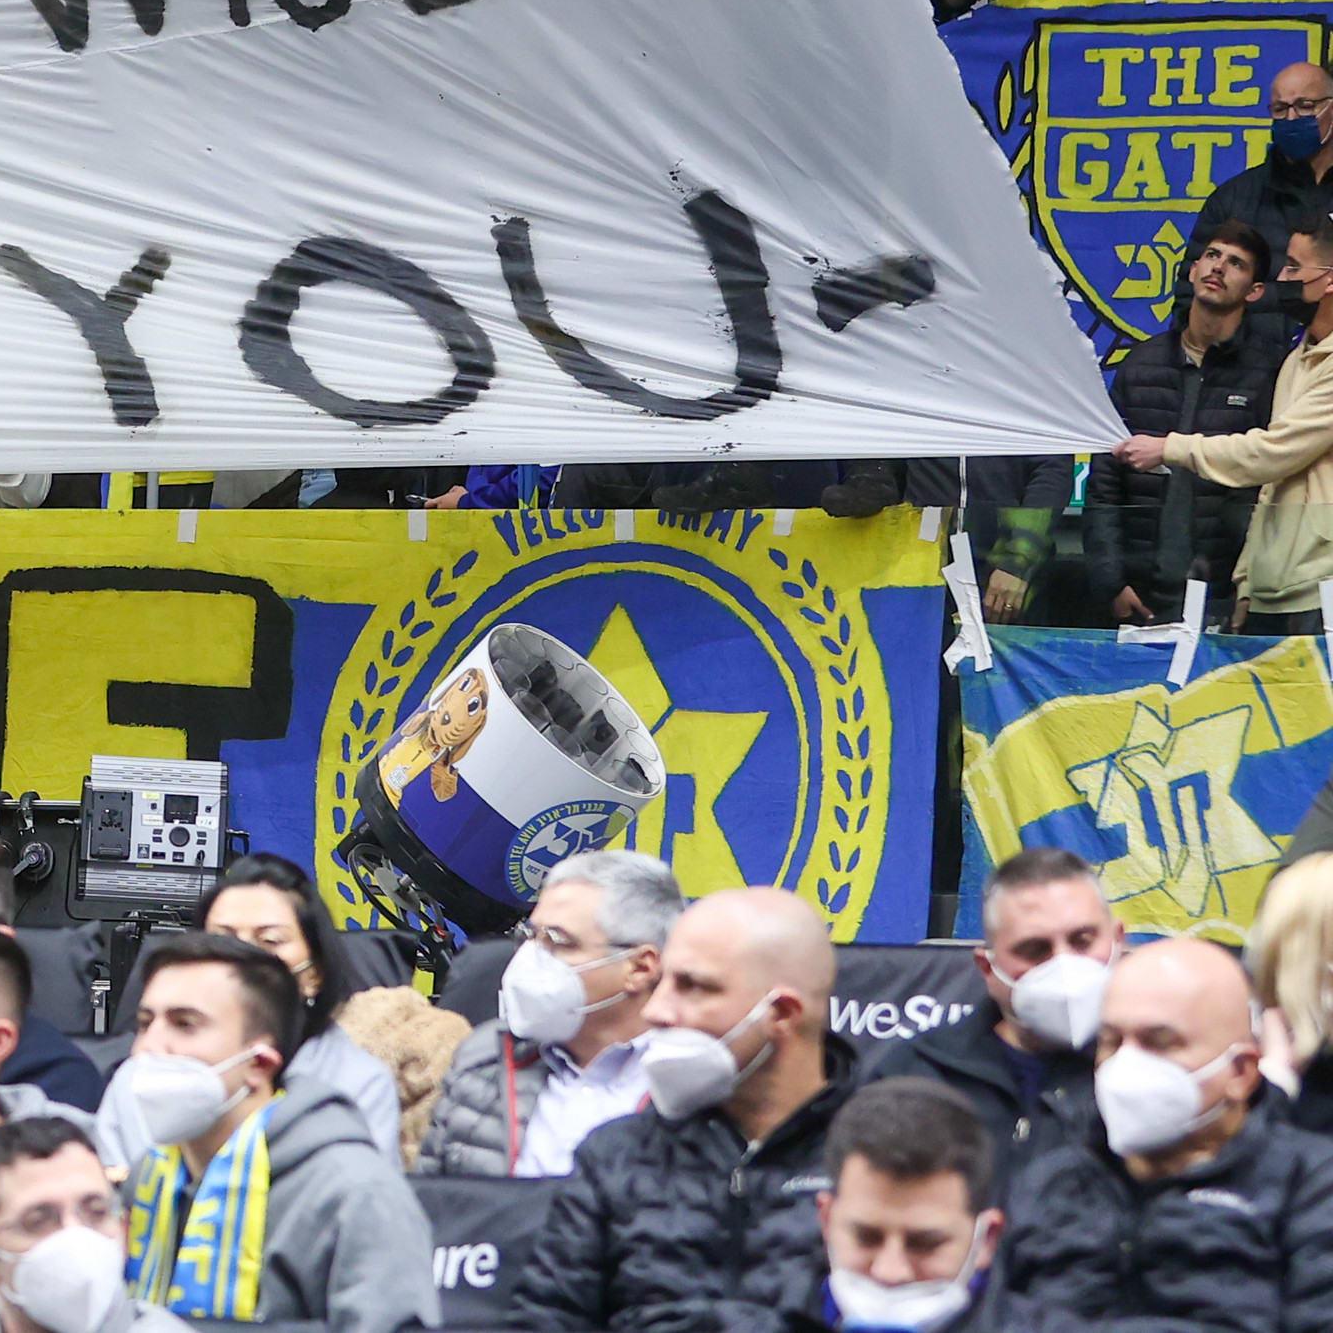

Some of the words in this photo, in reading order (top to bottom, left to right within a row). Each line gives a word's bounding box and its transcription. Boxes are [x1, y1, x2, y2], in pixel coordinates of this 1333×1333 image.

[1083, 44, 1262, 112] THE
[509, 844, 525, 861] TEL
[517, 823, 538, 846] AVIV
